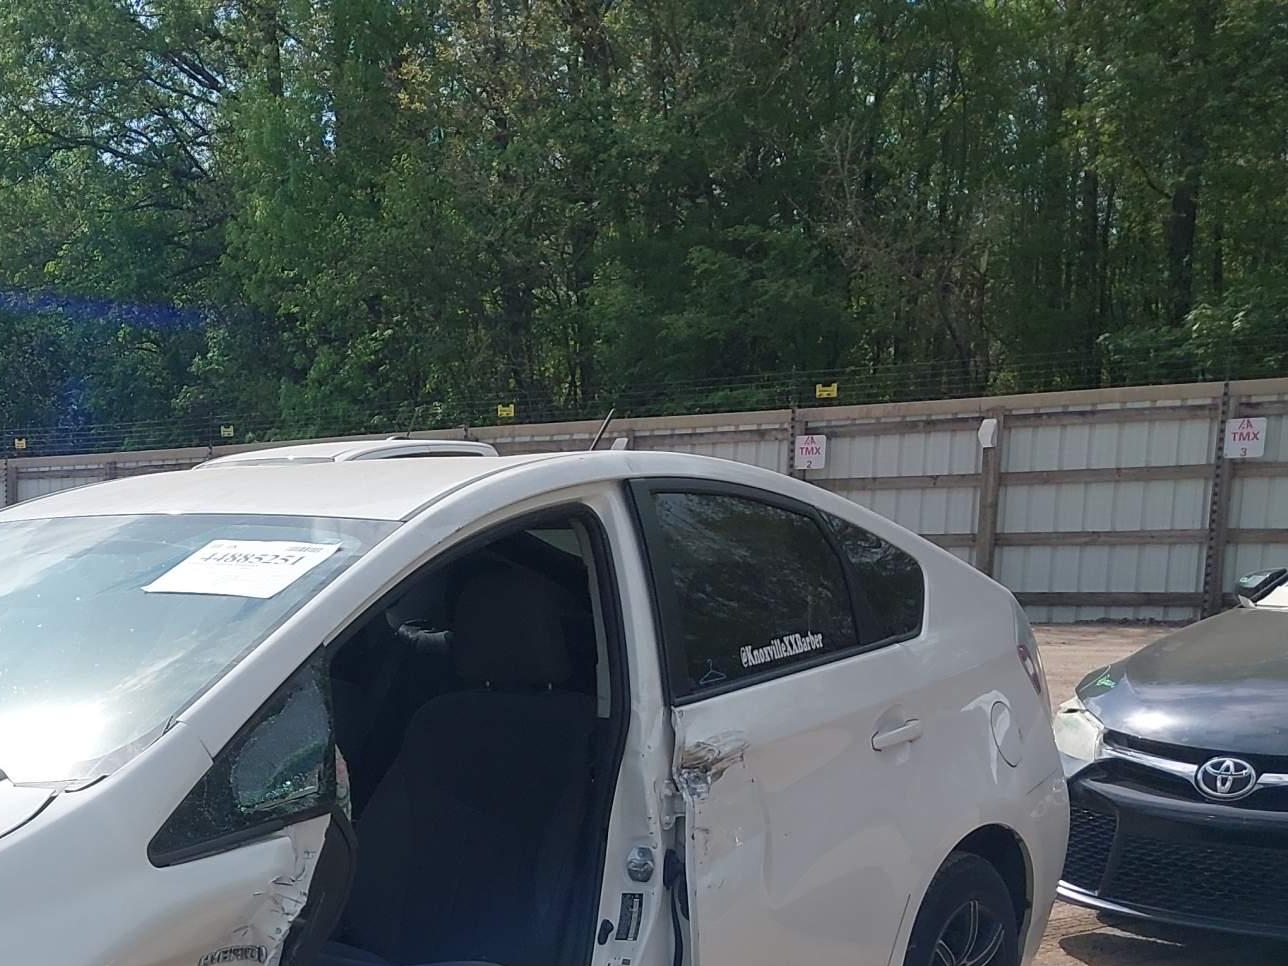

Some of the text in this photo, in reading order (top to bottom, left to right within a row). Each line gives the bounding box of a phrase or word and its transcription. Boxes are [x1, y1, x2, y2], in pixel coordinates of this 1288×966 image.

[1231, 431, 1260, 442] TMX
[799, 446, 821, 456] TMX
[1240, 447, 1248, 457] 3
[806, 459, 813, 468] 2
[199, 551, 305, 566] 44885251
[740, 630, 824, 668] @KnoxvilleXXBarber
